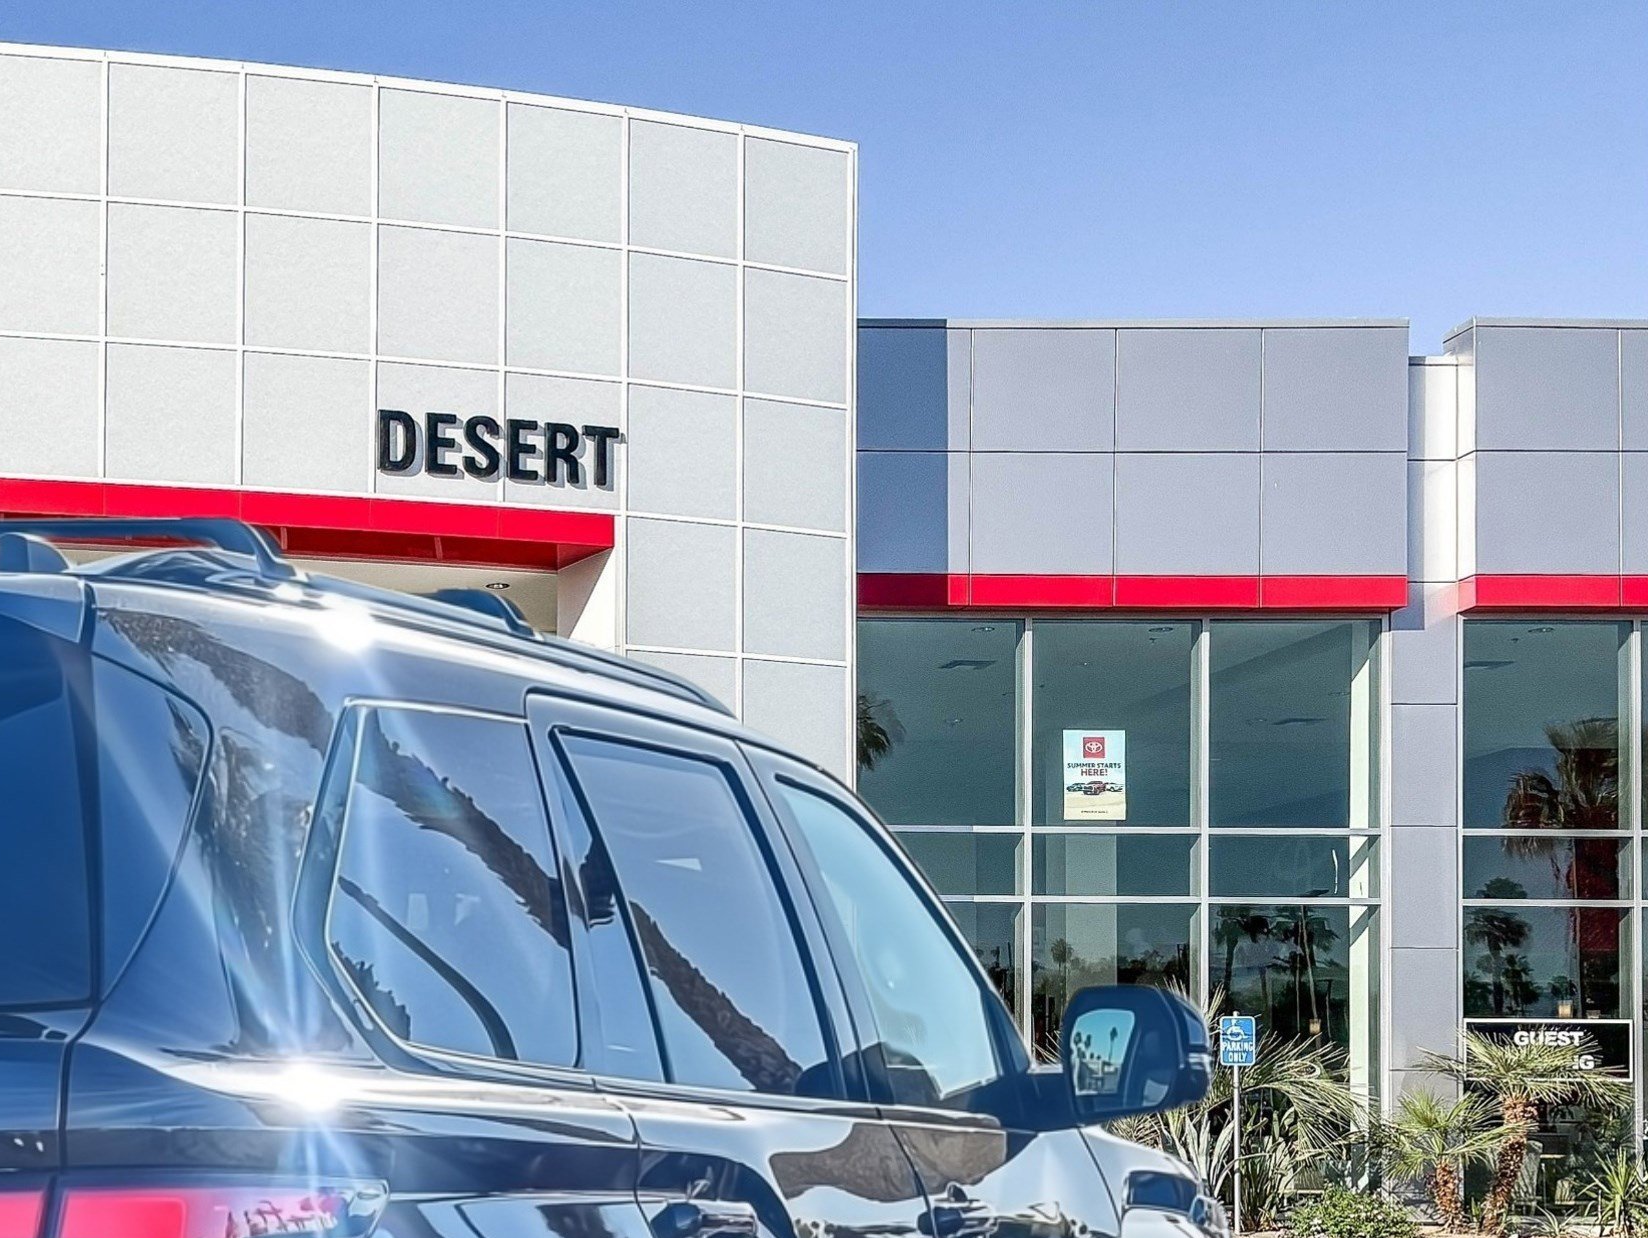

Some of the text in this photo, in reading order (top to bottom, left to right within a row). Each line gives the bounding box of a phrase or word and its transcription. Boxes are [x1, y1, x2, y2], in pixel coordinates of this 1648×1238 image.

[378, 409, 620, 486] DESERT
[1080, 768, 1108, 776] HERE!
[1513, 1029, 1584, 1047] GUEST
[1222, 1040, 1254, 1052] PARKING
[1228, 1051, 1248, 1063] ONLY
